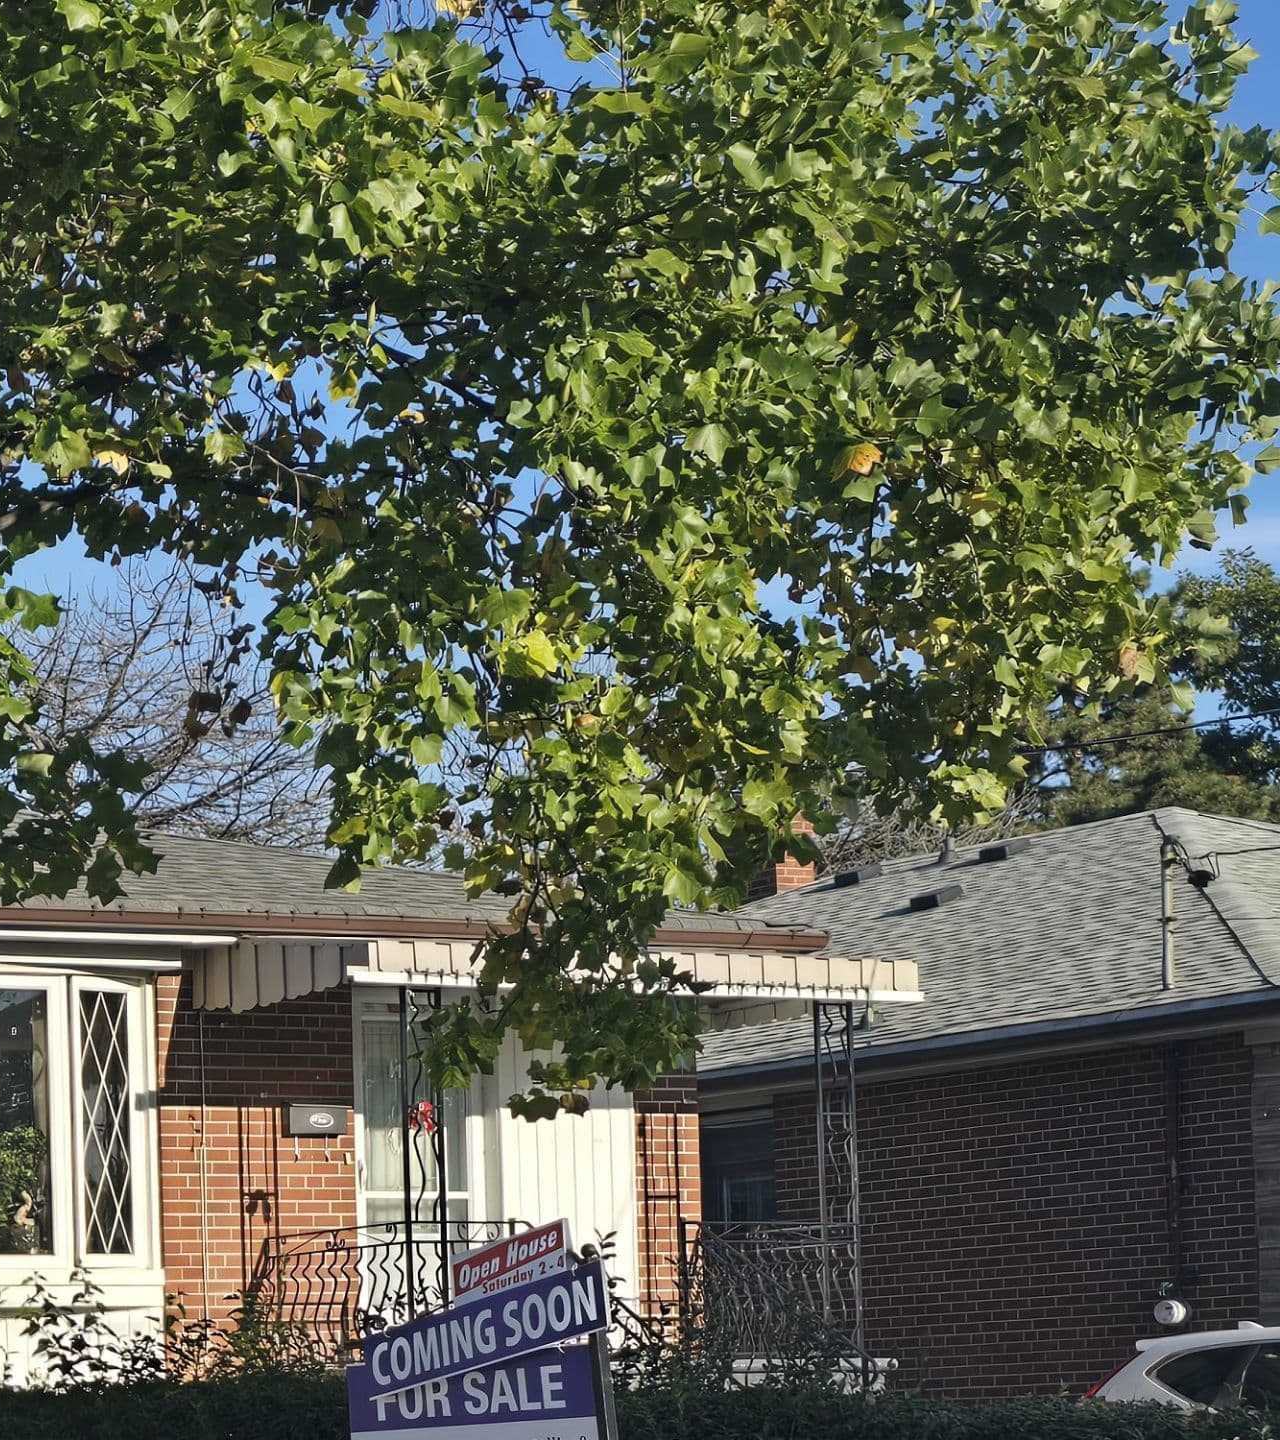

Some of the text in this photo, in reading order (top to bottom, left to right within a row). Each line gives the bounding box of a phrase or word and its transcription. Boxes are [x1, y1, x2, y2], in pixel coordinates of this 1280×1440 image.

[459, 1230, 558, 1288] Open House
[482, 1269, 534, 1294] Saturday
[538, 1262, 546, 1275] 2
[371, 1275, 597, 1386] COMING SOON
[462, 1364, 566, 1415] SALE
